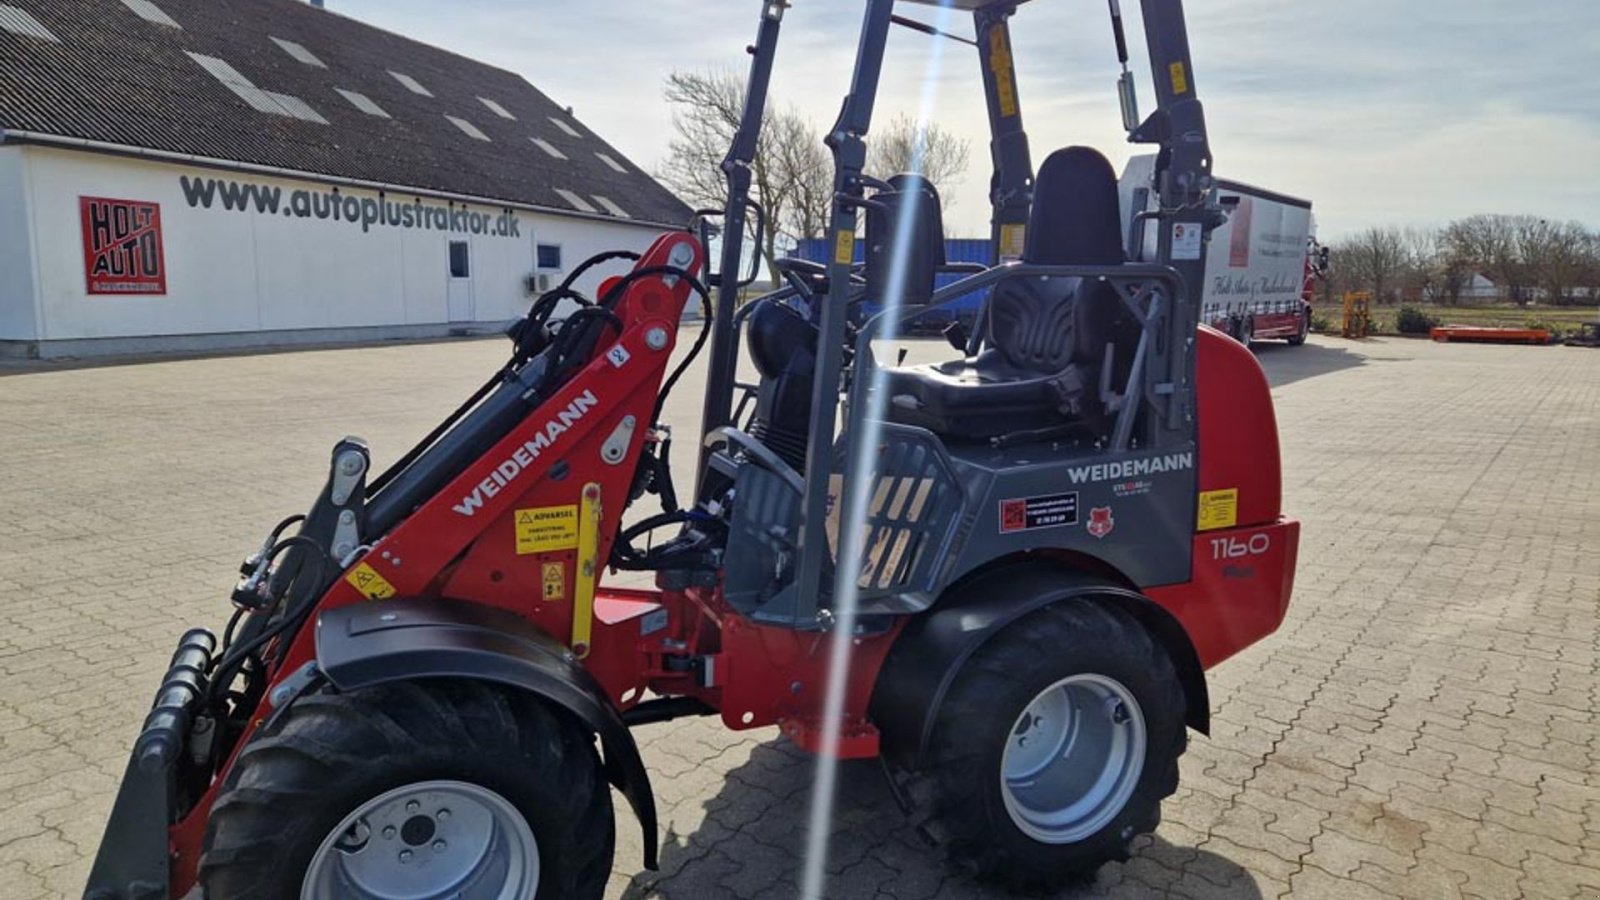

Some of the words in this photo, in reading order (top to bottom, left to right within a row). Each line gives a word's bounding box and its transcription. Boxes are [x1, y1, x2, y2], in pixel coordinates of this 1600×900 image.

[90, 202, 153, 251] HOLT
[180, 175, 520, 238] www.autoplustraktor.dk
[92, 230, 158, 276] AUTO
[452, 389, 598, 517] WEIDEMANN
[1067, 452, 1192, 484] WEIDEMANN
[1210, 533, 1270, 560] 1160
